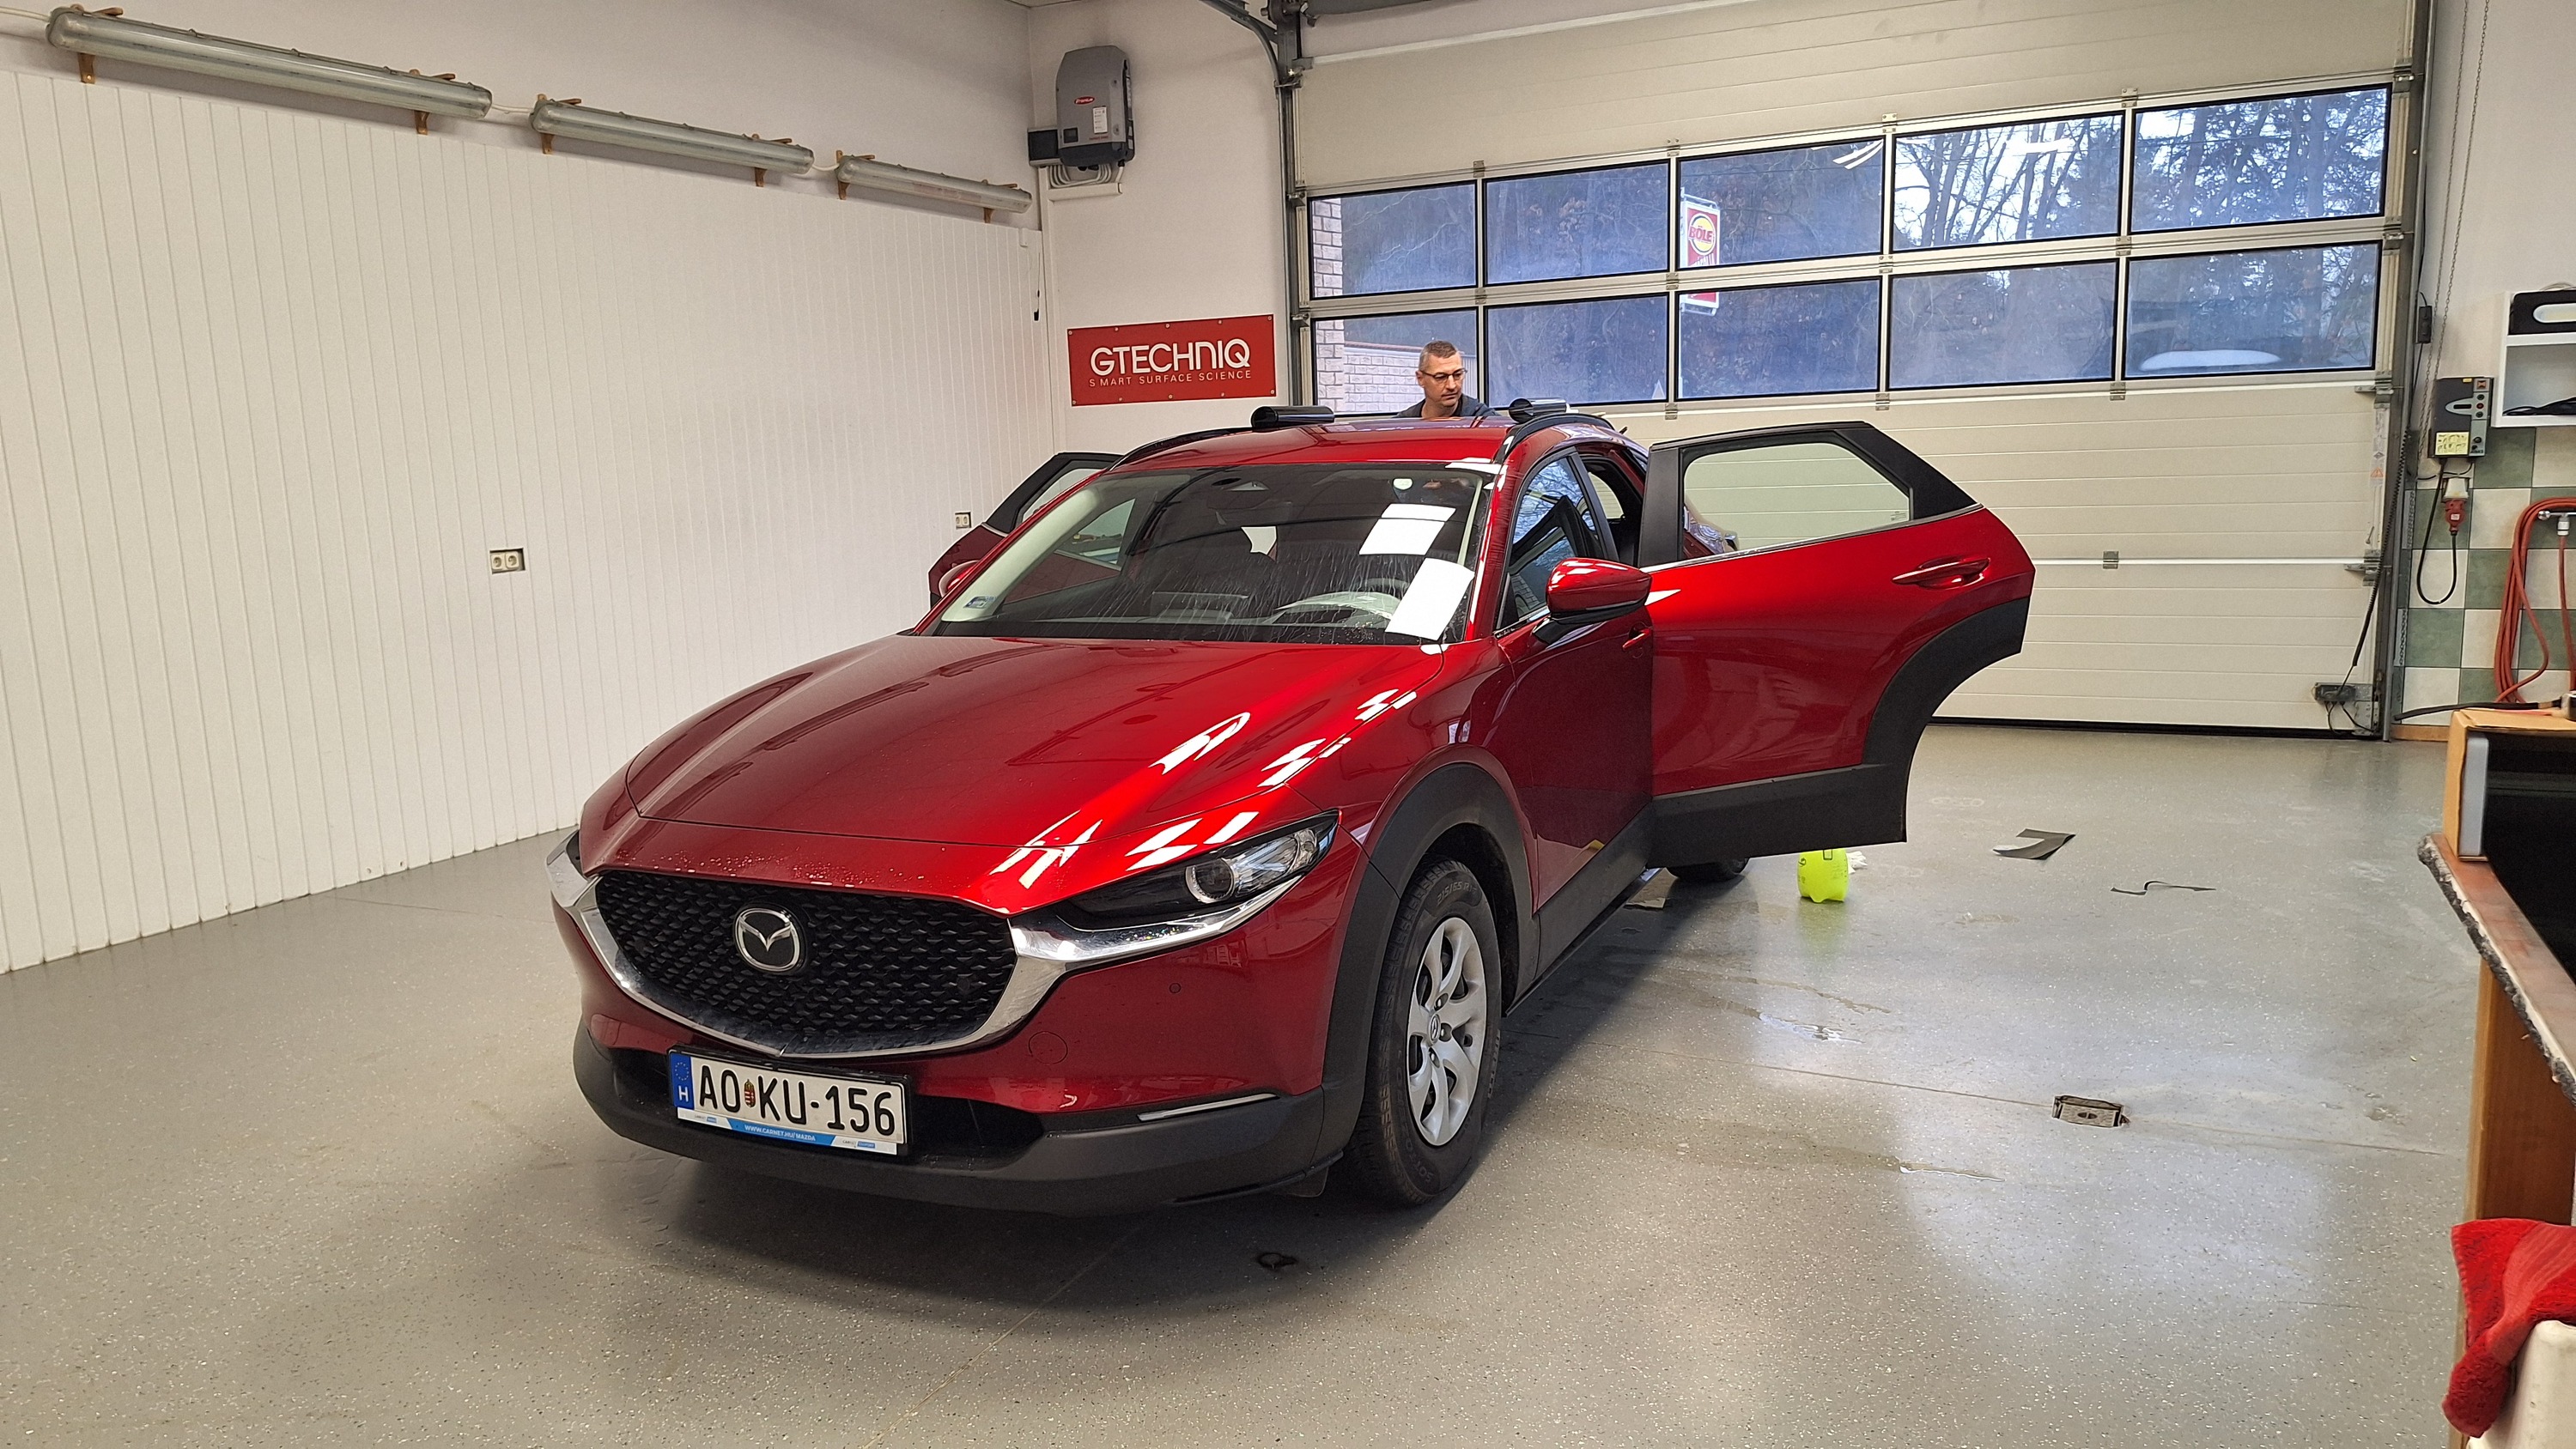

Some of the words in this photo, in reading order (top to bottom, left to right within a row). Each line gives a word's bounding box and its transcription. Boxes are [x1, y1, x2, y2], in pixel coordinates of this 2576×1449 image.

[1090, 338, 1250, 376] GTECHNIQ
[1139, 373, 1193, 385] SURFACE
[1199, 370, 1252, 381] SCIENCE
[678, 1085, 689, 1102] H
[699, 1065, 741, 1113] AO
[757, 1075, 896, 1137] KU-156
